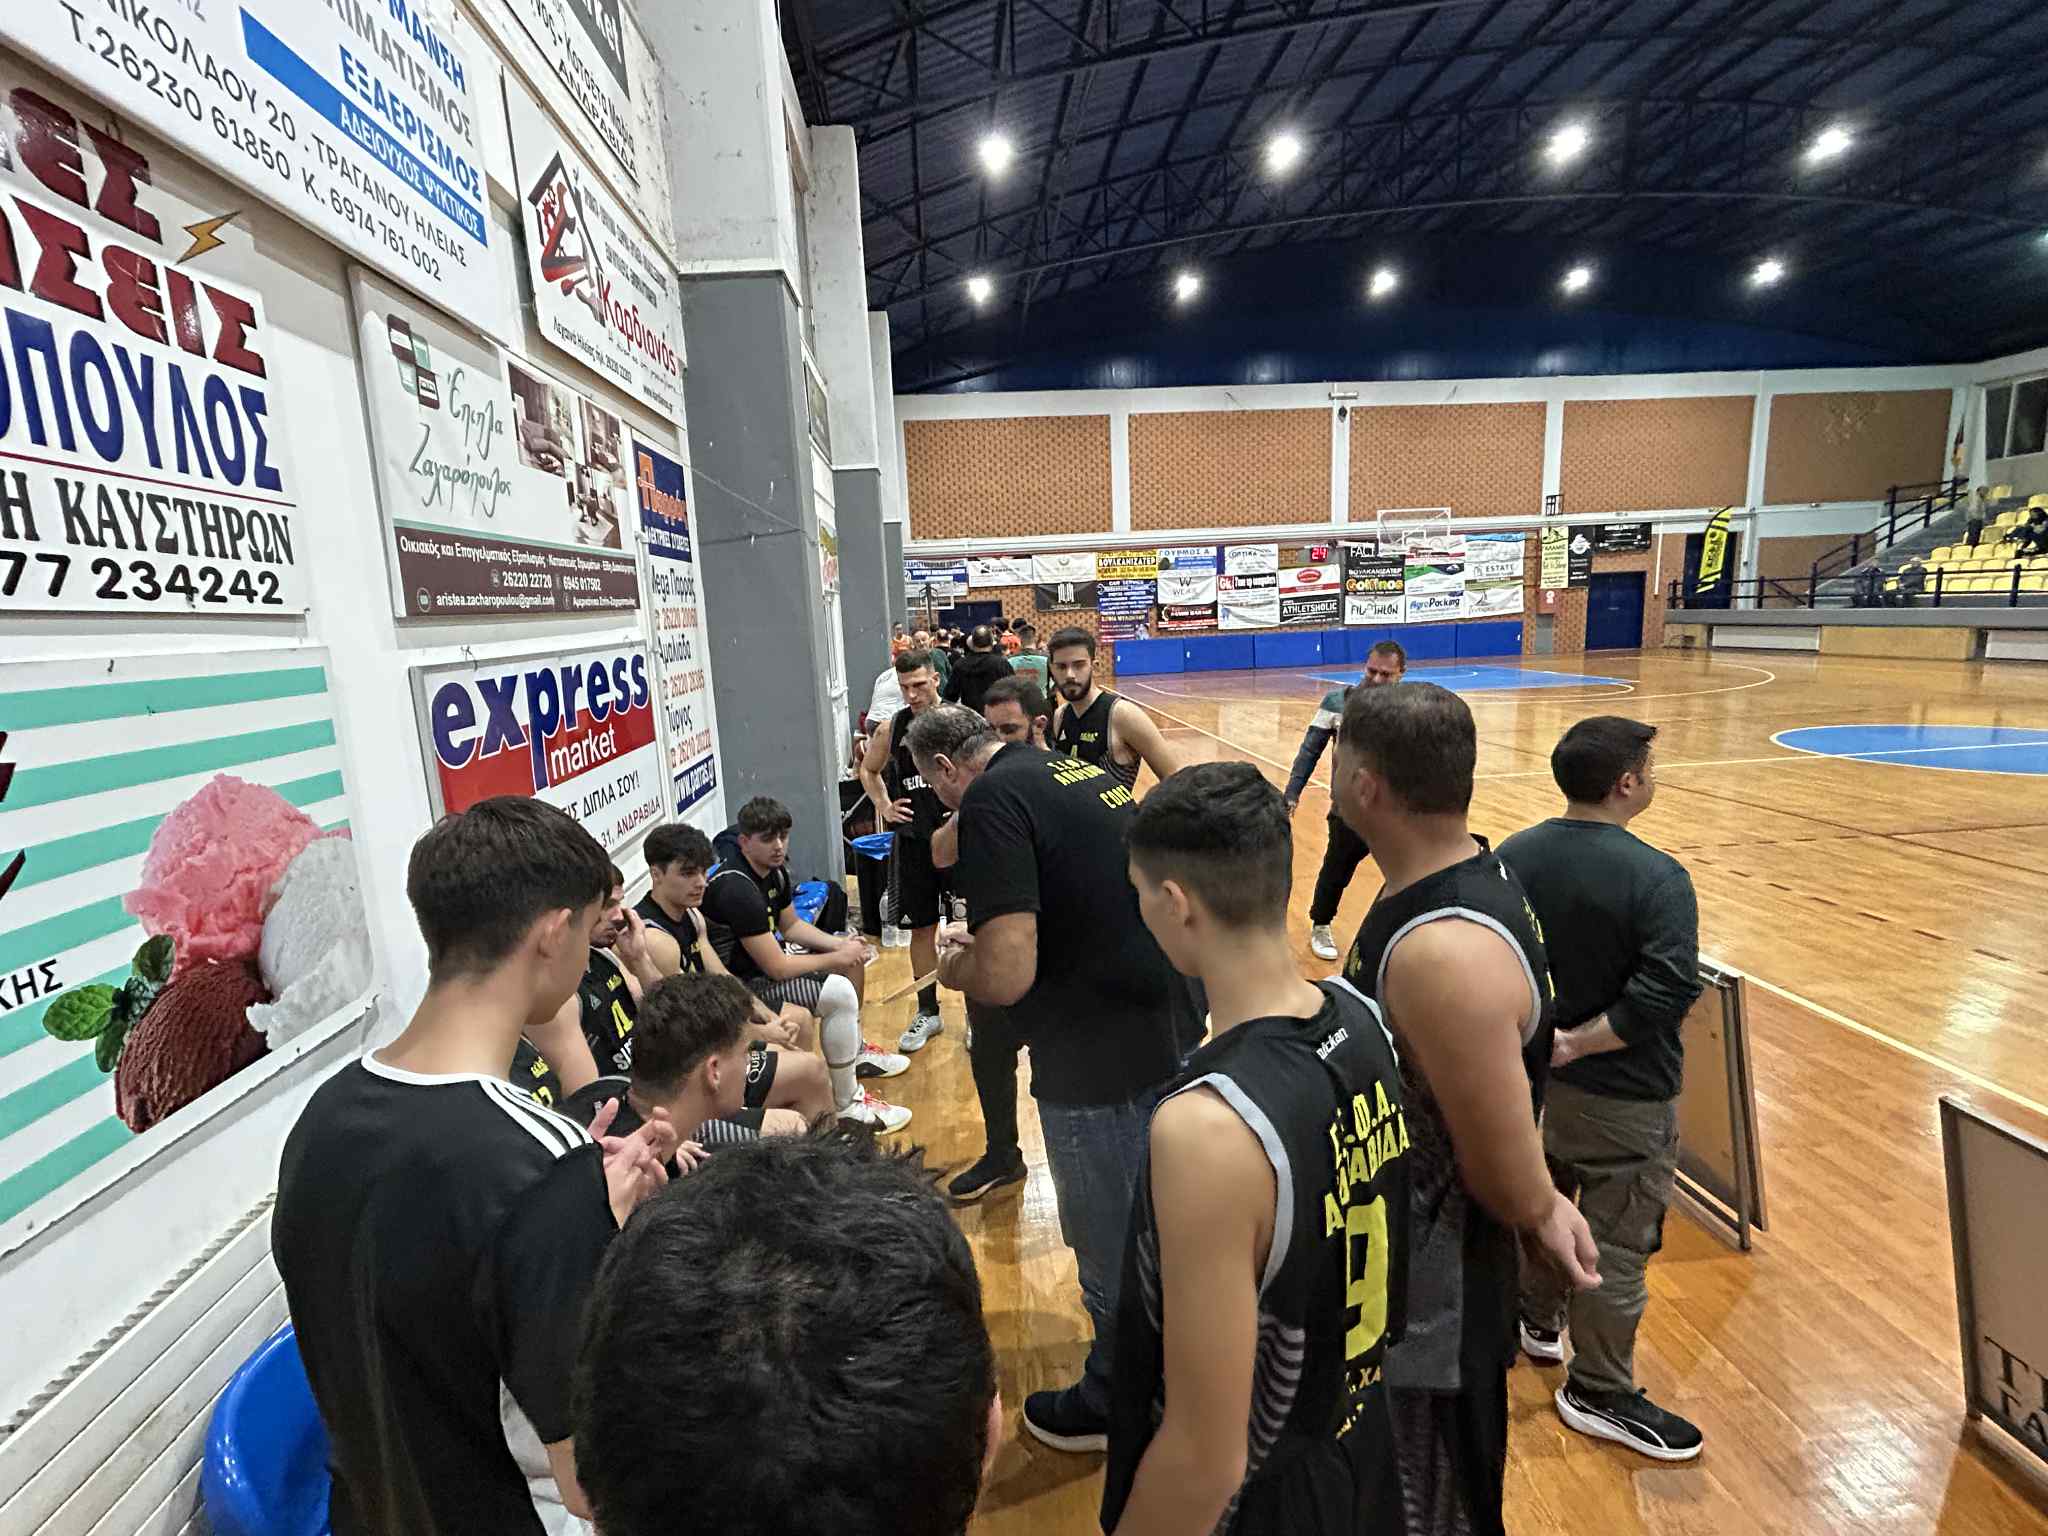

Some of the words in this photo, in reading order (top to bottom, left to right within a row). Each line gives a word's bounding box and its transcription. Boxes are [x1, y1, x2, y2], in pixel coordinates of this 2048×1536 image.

[326, 0, 473, 147] ΙΜΑΤΙΣΜΟΣ
[377, 0, 466, 95] ΜΑΝΣΗ
[339, 44, 482, 203] ΕΞΑΕΡΙΣΜΟΣ
[341, 102, 425, 191] ΑΔΕΙΟΥΧΟΣ
[424, 175, 480, 236] ΨΥΚΤΙΚΟΣ
[211, 106, 291, 181] 61850
[330, 187, 376, 239] 6974
[378, 220, 407, 263] 761
[411, 243, 442, 282] 002
[266, 101, 296, 142] 20
[414, 211, 466, 268] ΗΛΕΙΑΣ
[603, 279, 678, 378] Καρδιανός
[54, 477, 296, 566] ΚΑΥΣΤΗΡΩΝ
[400, 535, 441, 559] Οικιακός
[441, 544, 454, 557] και
[1311, 547, 1327, 560] 24
[91, 557, 284, 606] 234242
[431, 653, 649, 796] express
[550, 723, 617, 780] market
[583, 783, 616, 818] ΔΙΠΛΑ
[616, 770, 640, 798] ΣΟΥ!
